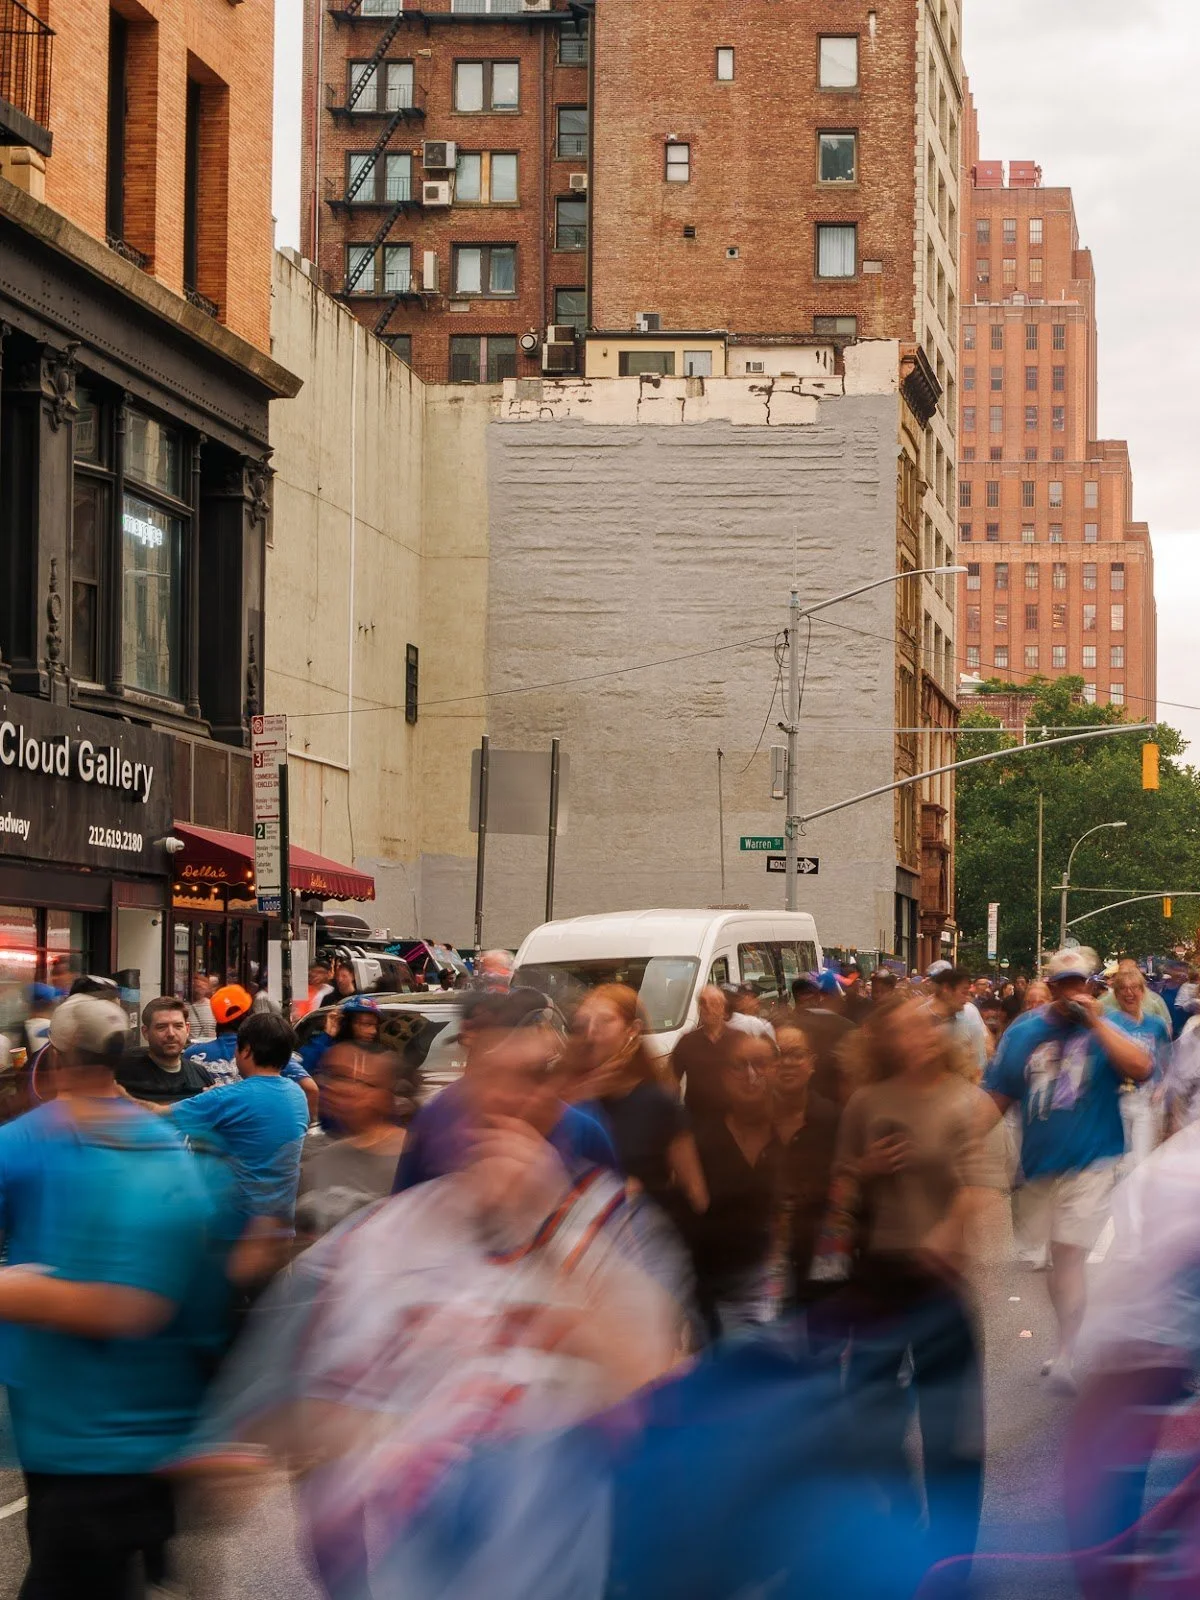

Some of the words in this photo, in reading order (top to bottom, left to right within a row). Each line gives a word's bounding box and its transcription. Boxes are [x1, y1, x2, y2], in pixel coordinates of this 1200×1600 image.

[0, 721, 70, 777] Cloud
[78, 740, 154, 803] Gallery
[255, 753, 261, 767] 3
[0, 812, 30, 841] adway
[257, 824, 264, 839] 2
[88, 825, 143, 853] 212.619.2180
[744, 838, 772, 849] Warren
